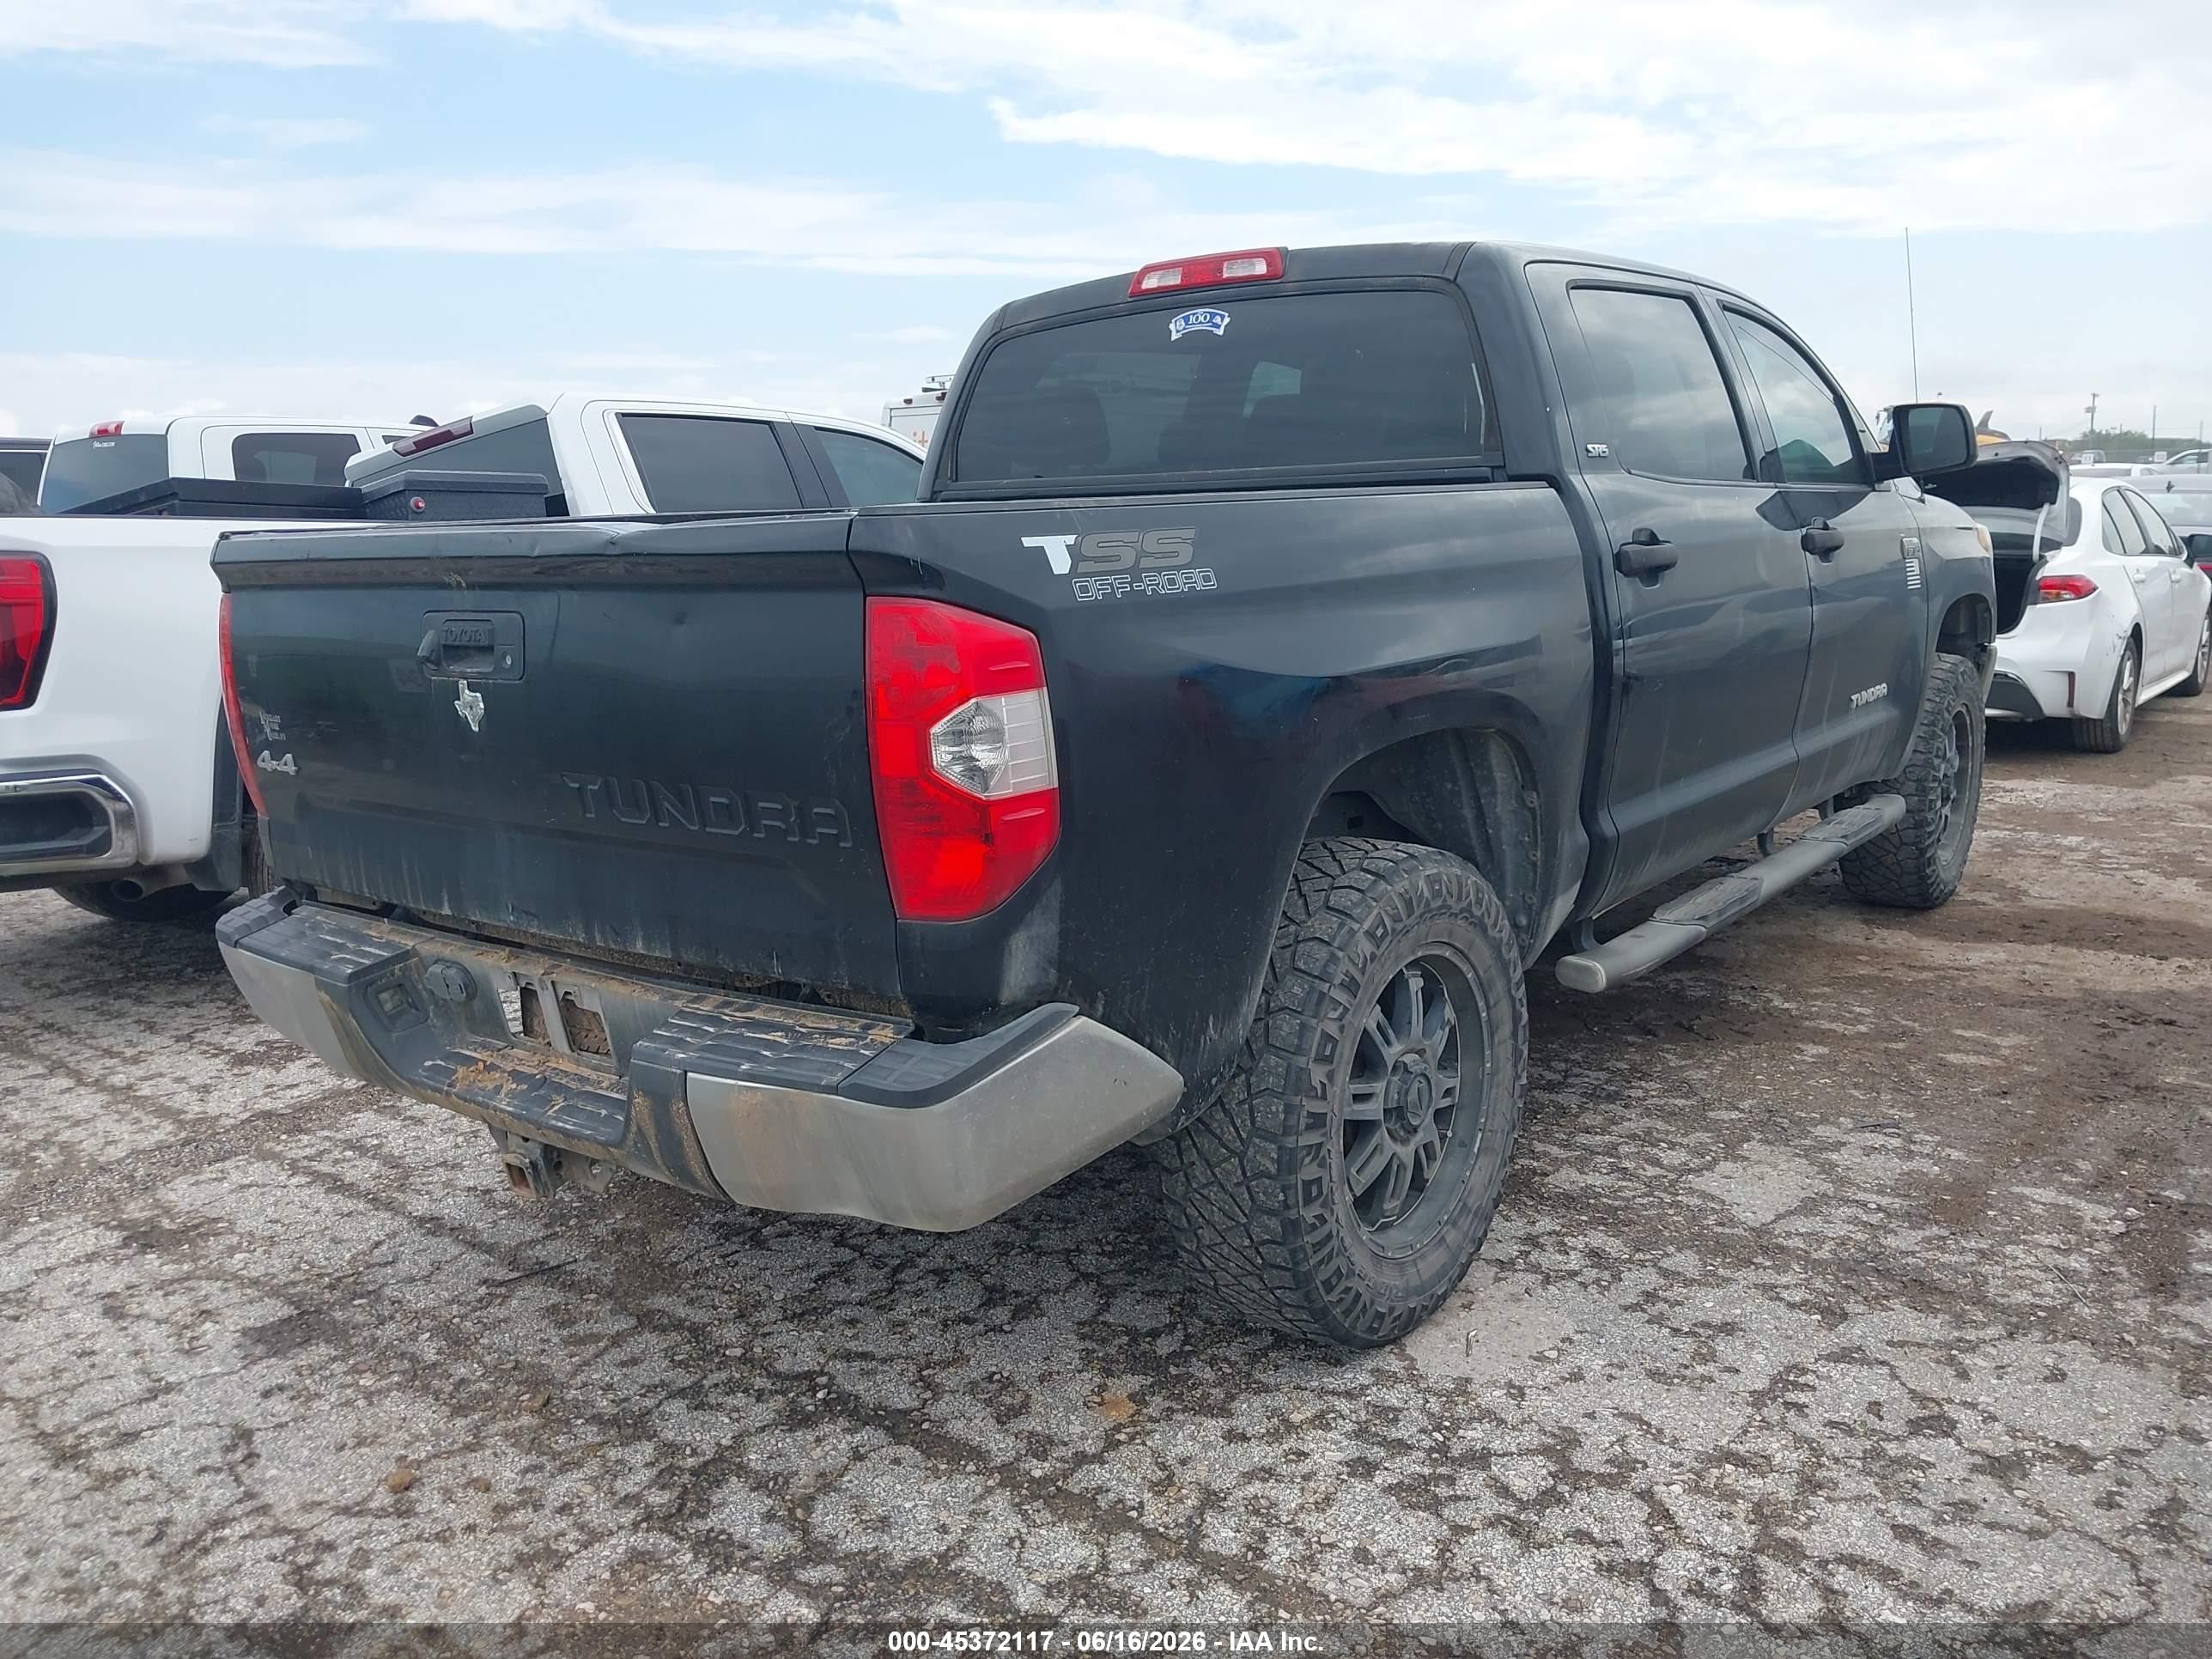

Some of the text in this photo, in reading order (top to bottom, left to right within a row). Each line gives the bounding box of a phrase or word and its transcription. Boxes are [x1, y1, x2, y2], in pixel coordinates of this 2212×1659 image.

[1188, 313, 1211, 325] 100
[1020, 526, 1196, 575] TSS
[1072, 568, 1218, 601] OFF-ROAD
[1849, 682, 1888, 708] TUNDRA
[562, 772, 854, 848] TUNDRA
